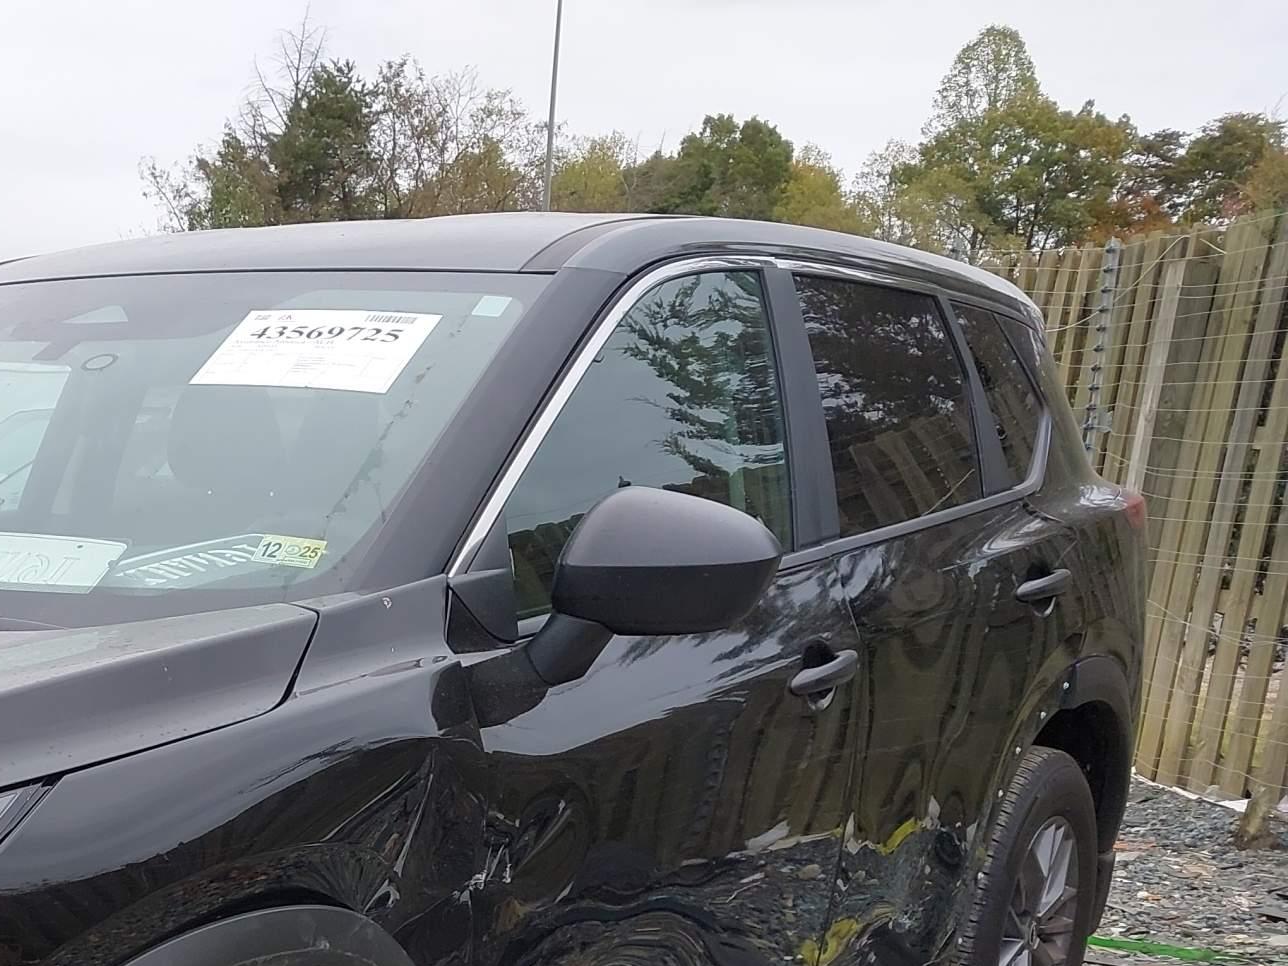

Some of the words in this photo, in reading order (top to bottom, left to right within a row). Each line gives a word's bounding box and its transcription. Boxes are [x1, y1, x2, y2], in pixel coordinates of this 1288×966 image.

[250, 325, 404, 343] 43569725
[261, 541, 282, 559] 12
[298, 545, 321, 559] 25
